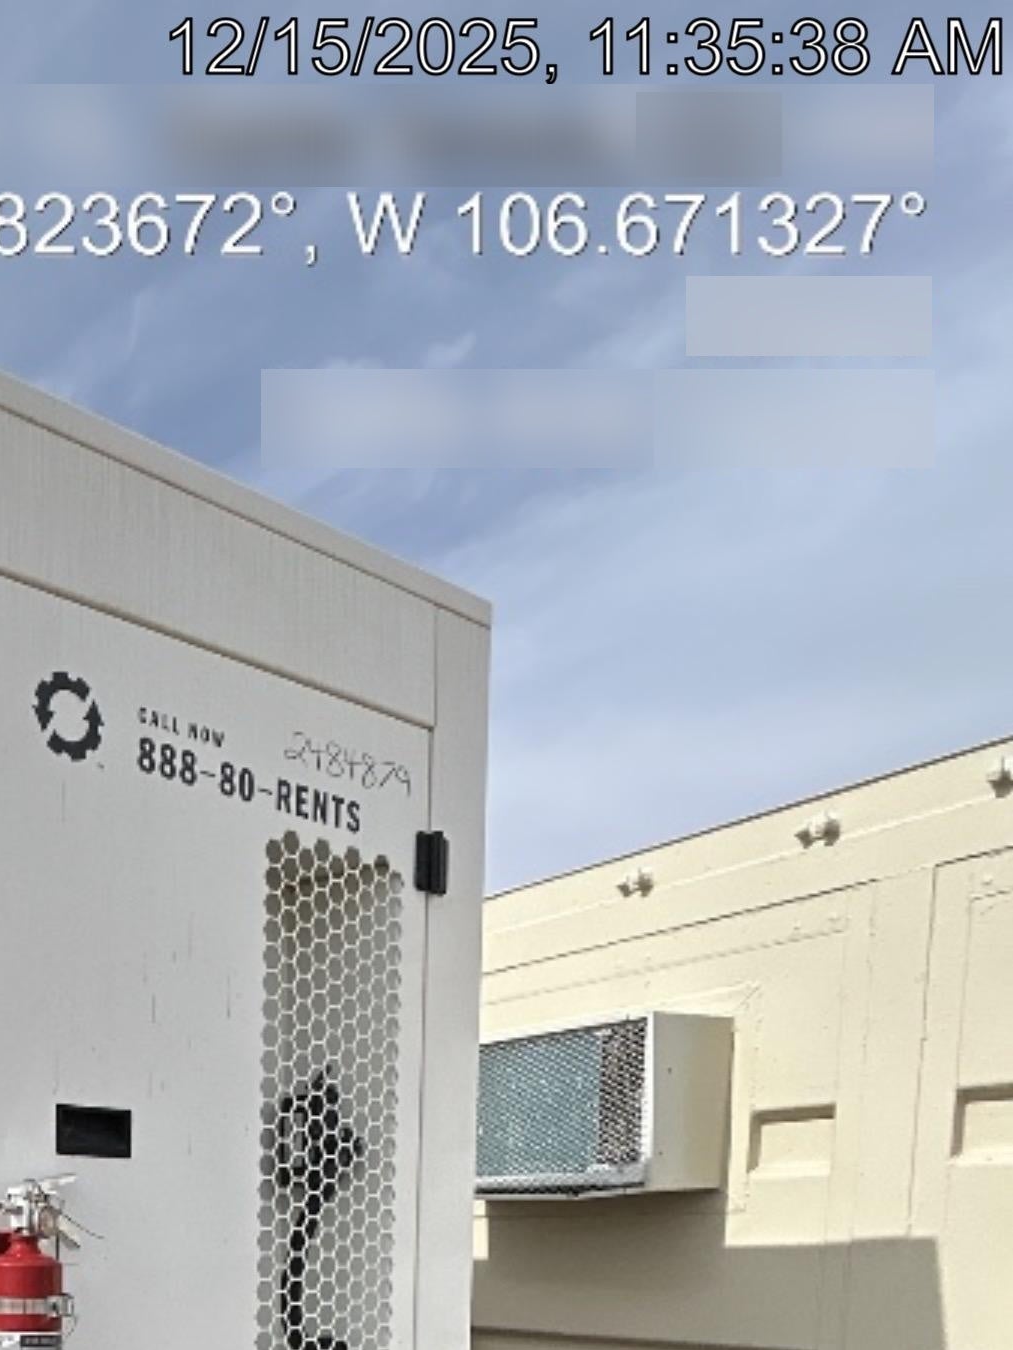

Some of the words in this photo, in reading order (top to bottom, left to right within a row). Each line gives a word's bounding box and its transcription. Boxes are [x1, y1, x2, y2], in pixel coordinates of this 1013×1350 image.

[137, 706, 180, 736] CALL
[188, 722, 226, 748] NOW
[136, 737, 361, 834] 888-80-RENTS
[284, 731, 411, 797] 2484879
